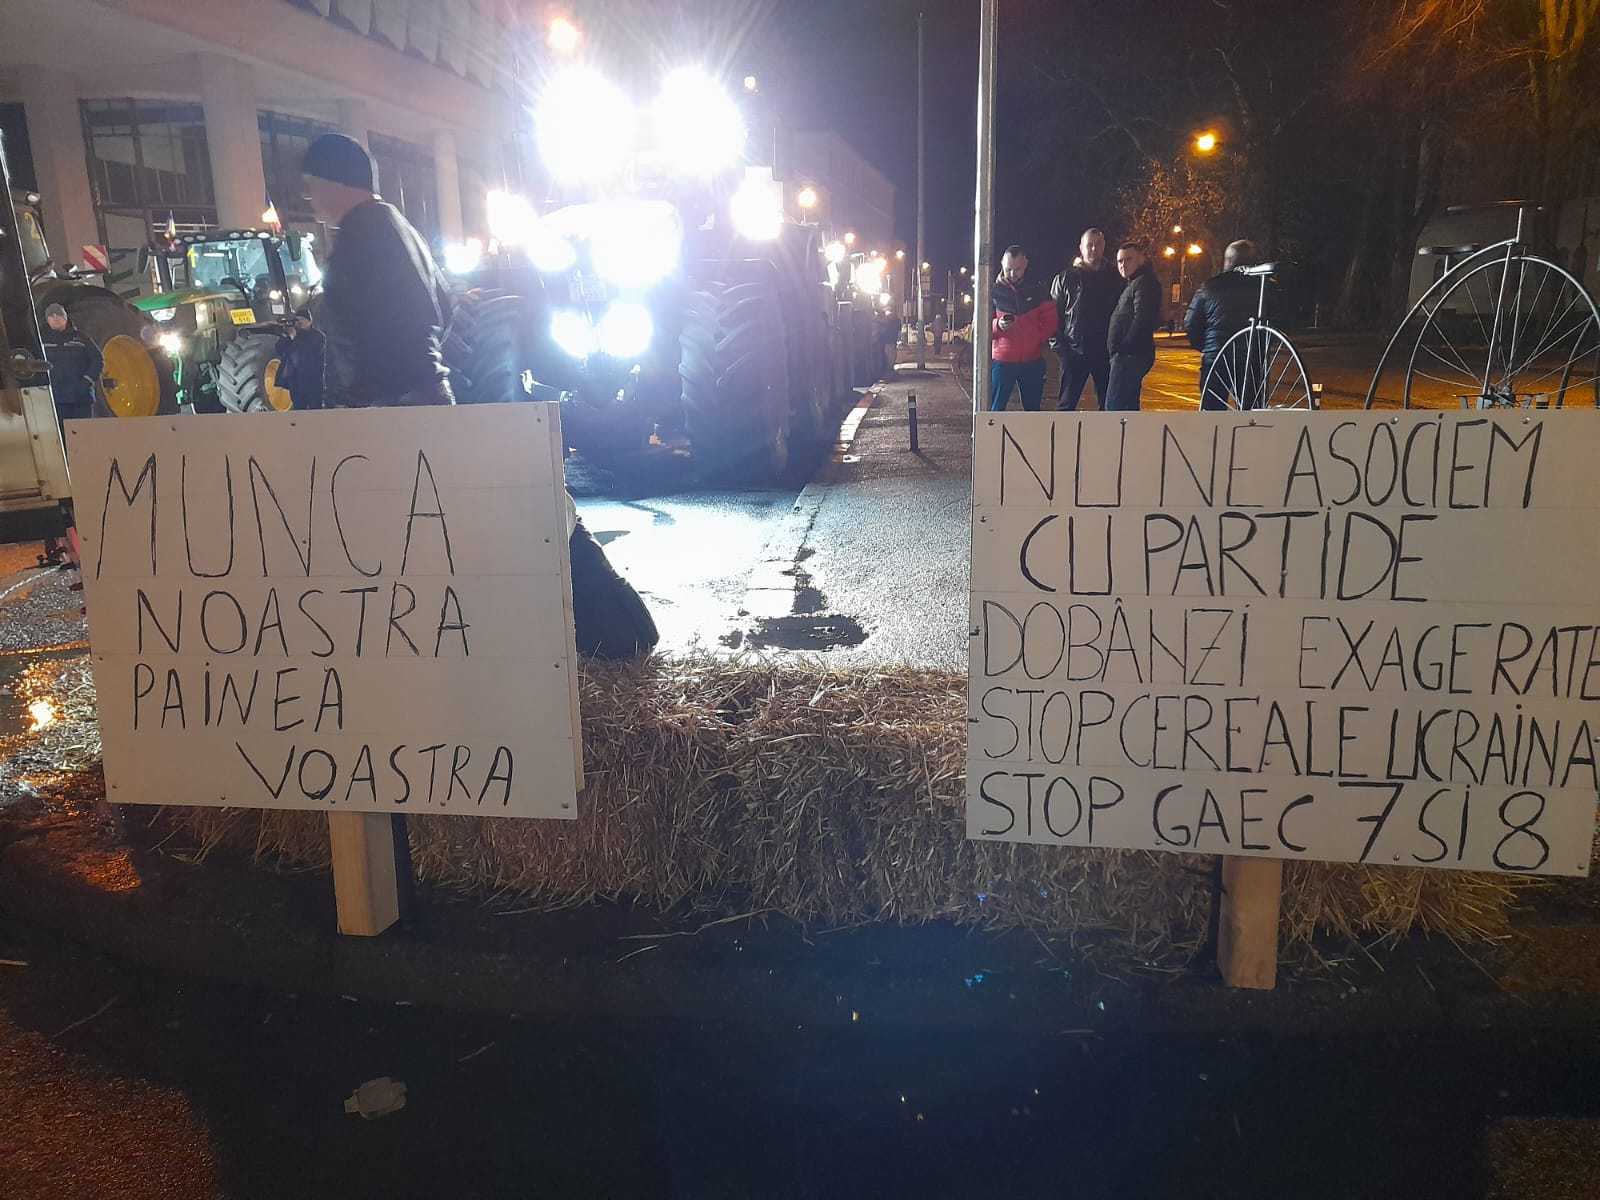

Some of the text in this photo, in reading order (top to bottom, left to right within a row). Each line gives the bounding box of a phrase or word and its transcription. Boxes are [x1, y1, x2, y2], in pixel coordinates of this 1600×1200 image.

[1000, 413, 1544, 509] NU NE ASOCIEM
[96, 449, 455, 579] MUNCA
[1020, 507, 1439, 602] CU PARTIDE
[137, 581, 471, 658] NOASTRA
[981, 598, 1600, 700] DOBÂNZI EXAGERATE
[133, 661, 344, 732] PAINEA
[981, 688, 1598, 791] STOP CEREALE UCRAINA
[235, 742, 515, 806] VOASTRA
[979, 771, 1550, 870] STOP GAEC 7 SI 8
